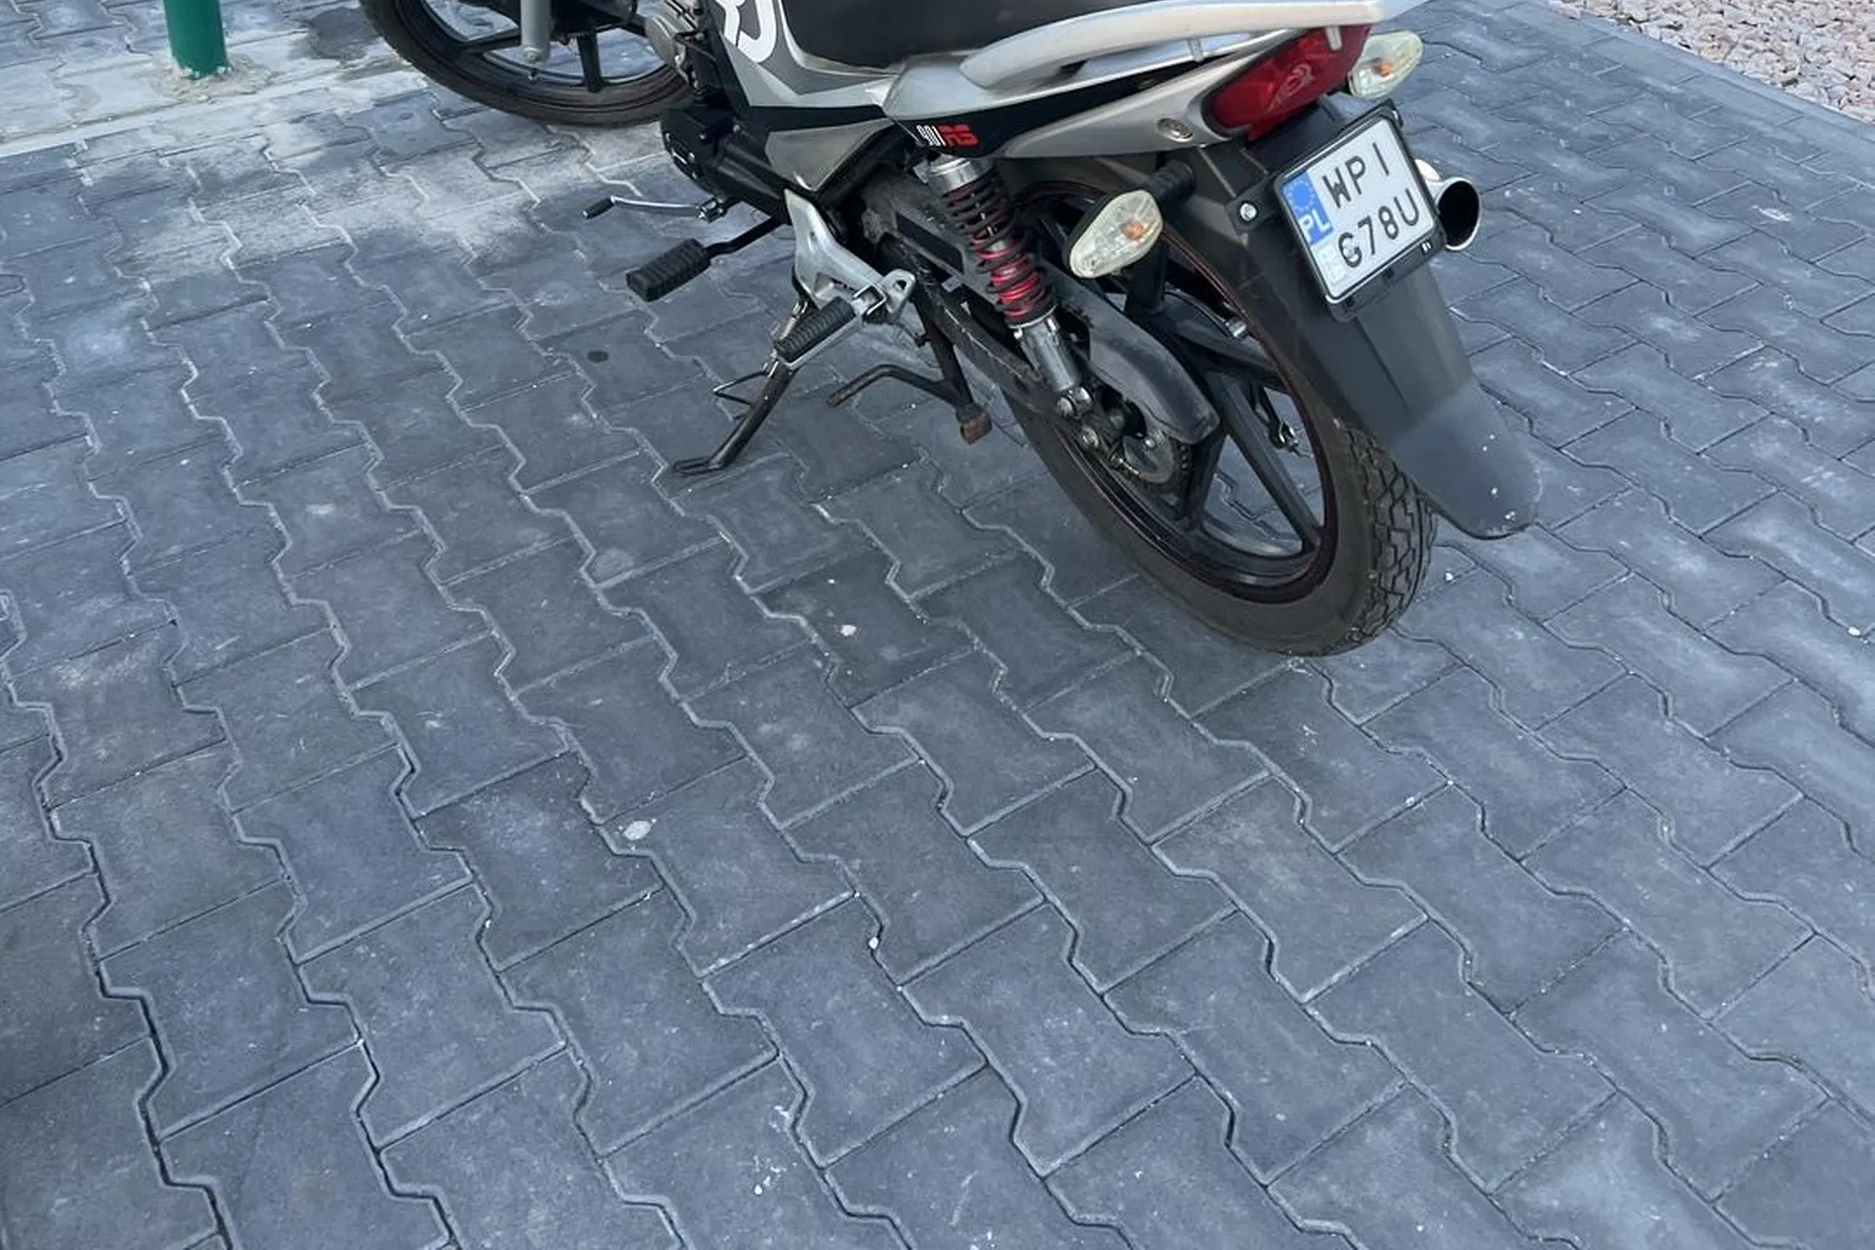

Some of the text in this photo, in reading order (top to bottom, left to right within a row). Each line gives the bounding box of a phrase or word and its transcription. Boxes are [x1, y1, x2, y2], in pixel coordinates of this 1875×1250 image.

[1323, 141, 1390, 209] WPI
[1297, 210, 1331, 237] PL
[1337, 187, 1420, 269] G78U
